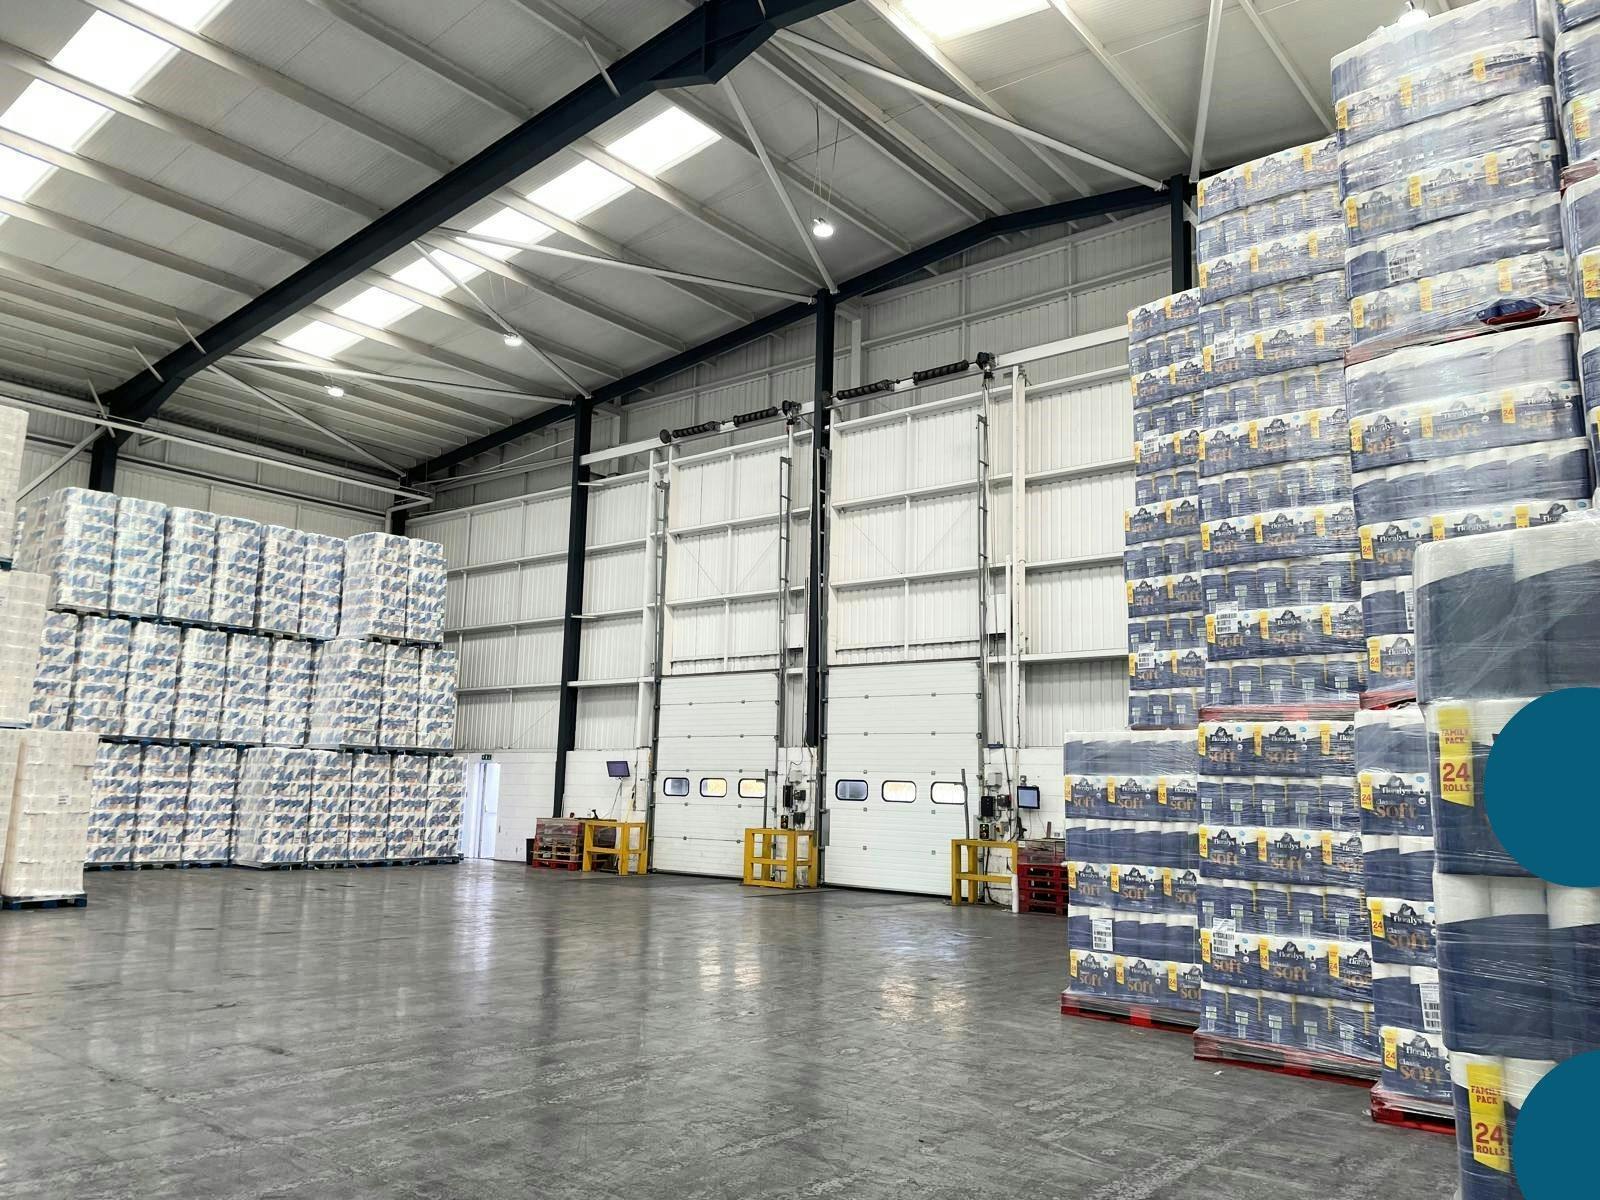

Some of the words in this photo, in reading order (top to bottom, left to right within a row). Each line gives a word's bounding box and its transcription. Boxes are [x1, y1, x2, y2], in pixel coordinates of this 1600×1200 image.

[1585, 279, 1598, 289] 24
[1503, 408, 1513, 417] 24
[1362, 545, 1371, 553] 24
[1371, 656, 1379, 664] 24
[1442, 763, 1470, 782] 24
[1443, 783, 1471, 792] ROLLS
[1376, 802, 1416, 818] soft
[1373, 920, 1383, 929] 24
[1388, 932, 1429, 950] soft
[1212, 958, 1242, 974] soft
[1128, 980, 1154, 994] soft
[1385, 1050, 1396, 1060] 24
[1476, 1095, 1498, 1105] PACK
[1475, 1122, 1504, 1146] 24
[1476, 1145, 1506, 1157] ROLLS
